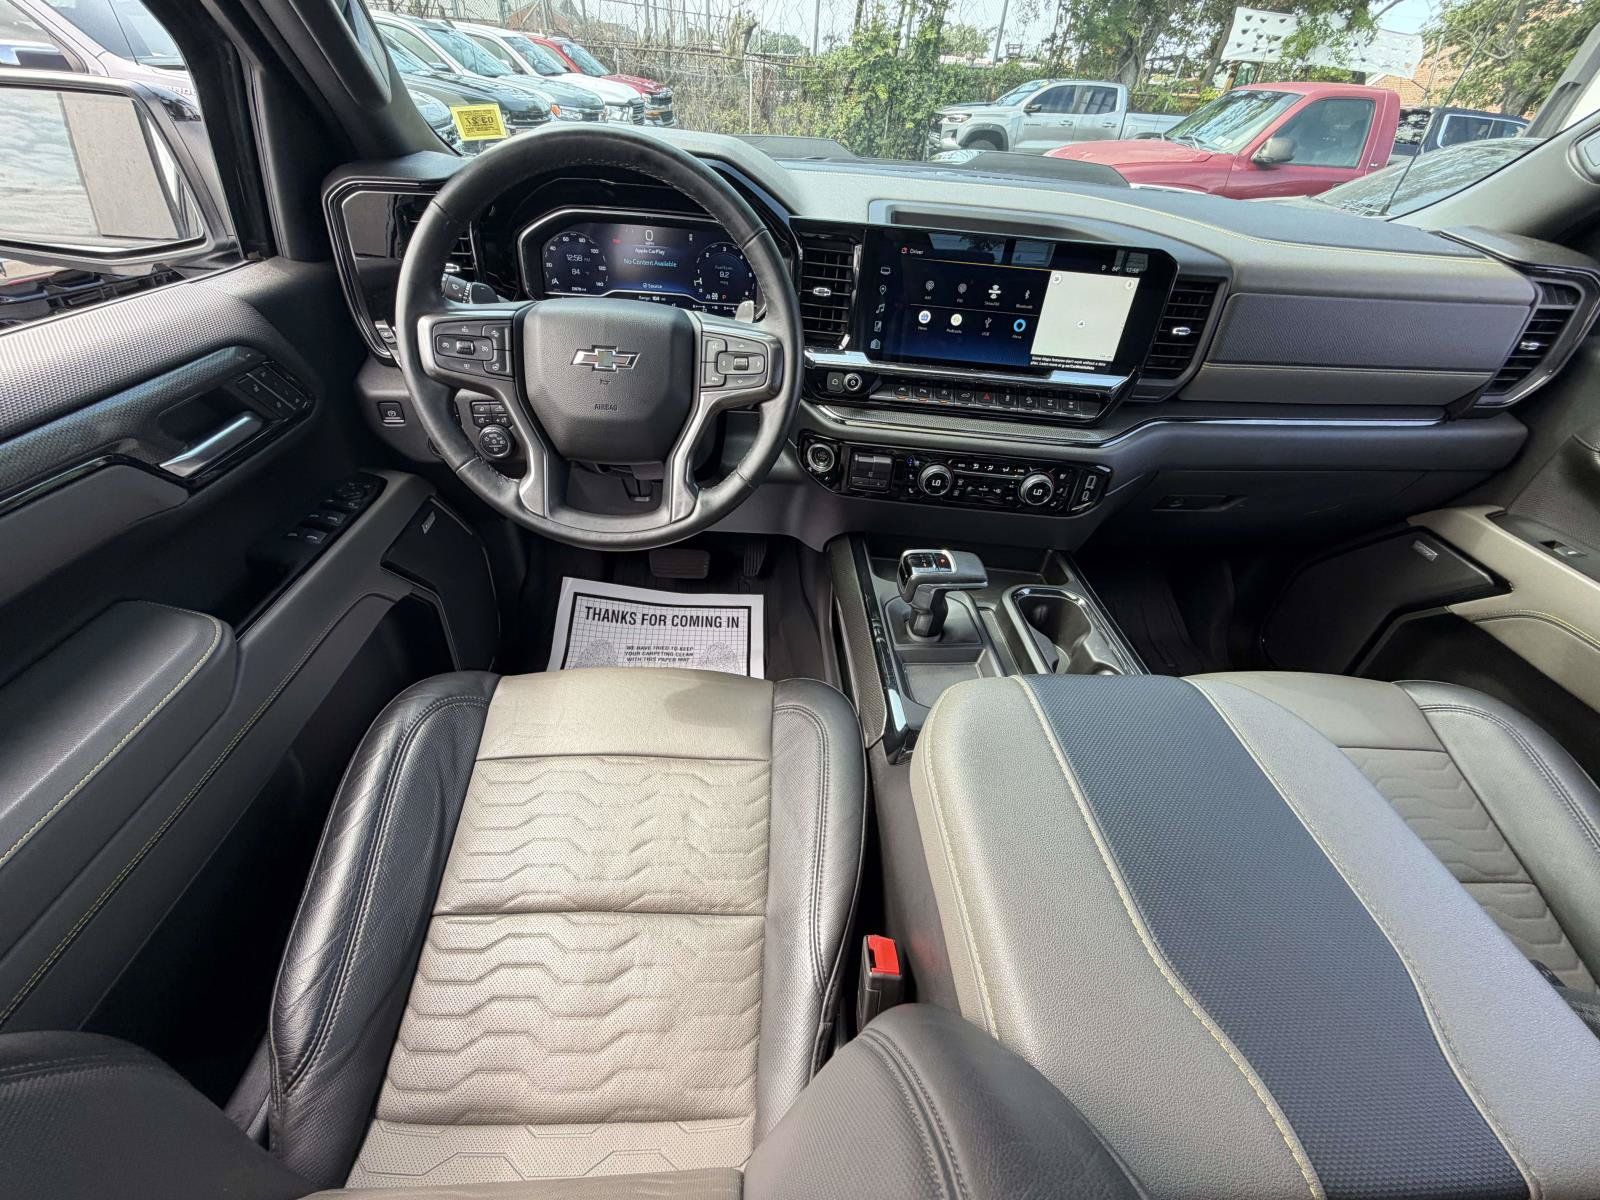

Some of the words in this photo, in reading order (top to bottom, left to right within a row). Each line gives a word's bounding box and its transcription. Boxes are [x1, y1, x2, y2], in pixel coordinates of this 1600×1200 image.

[584, 606, 637, 626] THANKS
[641, 613, 667, 627] FOR
[671, 615, 722, 629] COMING
[726, 616, 740, 629] IN
